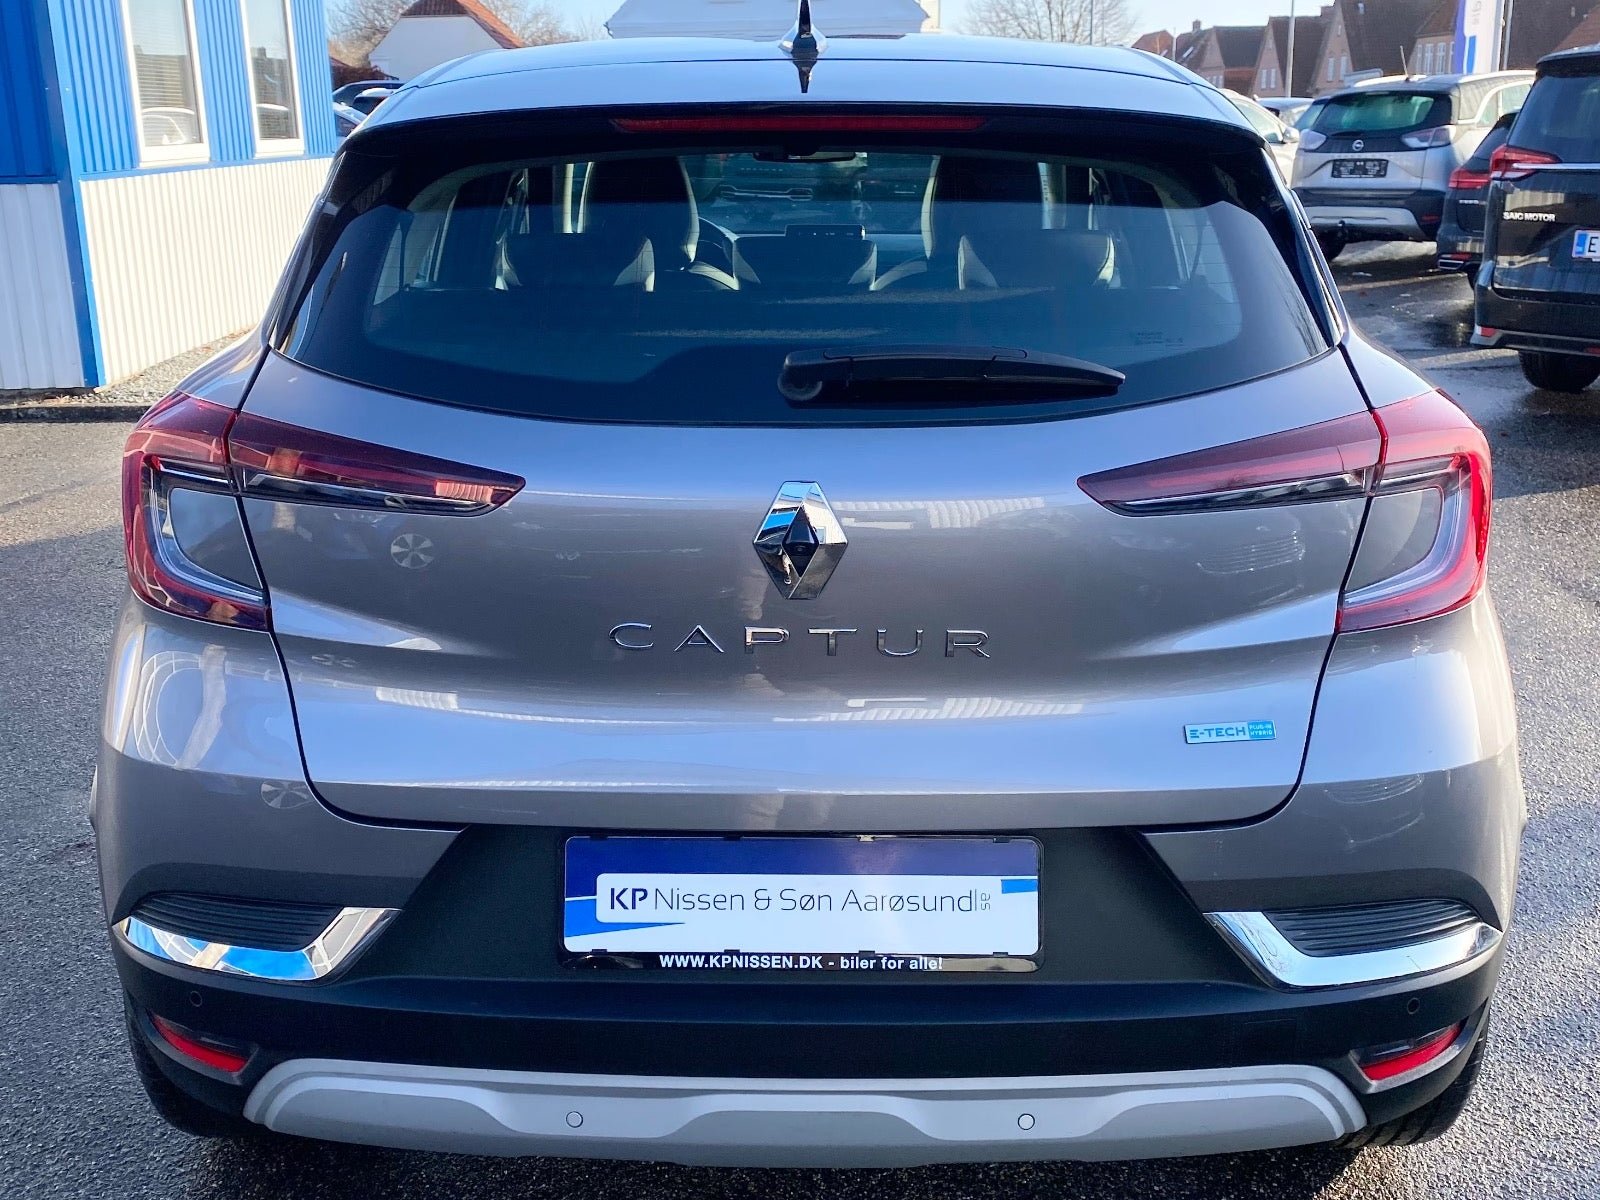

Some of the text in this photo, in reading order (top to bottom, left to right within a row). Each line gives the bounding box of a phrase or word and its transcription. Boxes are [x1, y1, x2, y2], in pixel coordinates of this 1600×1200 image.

[1503, 212, 1555, 221] SAIC MOTOR
[608, 622, 991, 658] CAPTUR
[1189, 726, 1246, 739] E-TECH
[610, 887, 973, 912] KP Nissen & Søn Aarøsund
[659, 954, 823, 970] WWW.KPNISSEN.DK
[840, 956, 876, 970] biler
[880, 956, 905, 970] for
[908, 956, 943, 971] alle!
